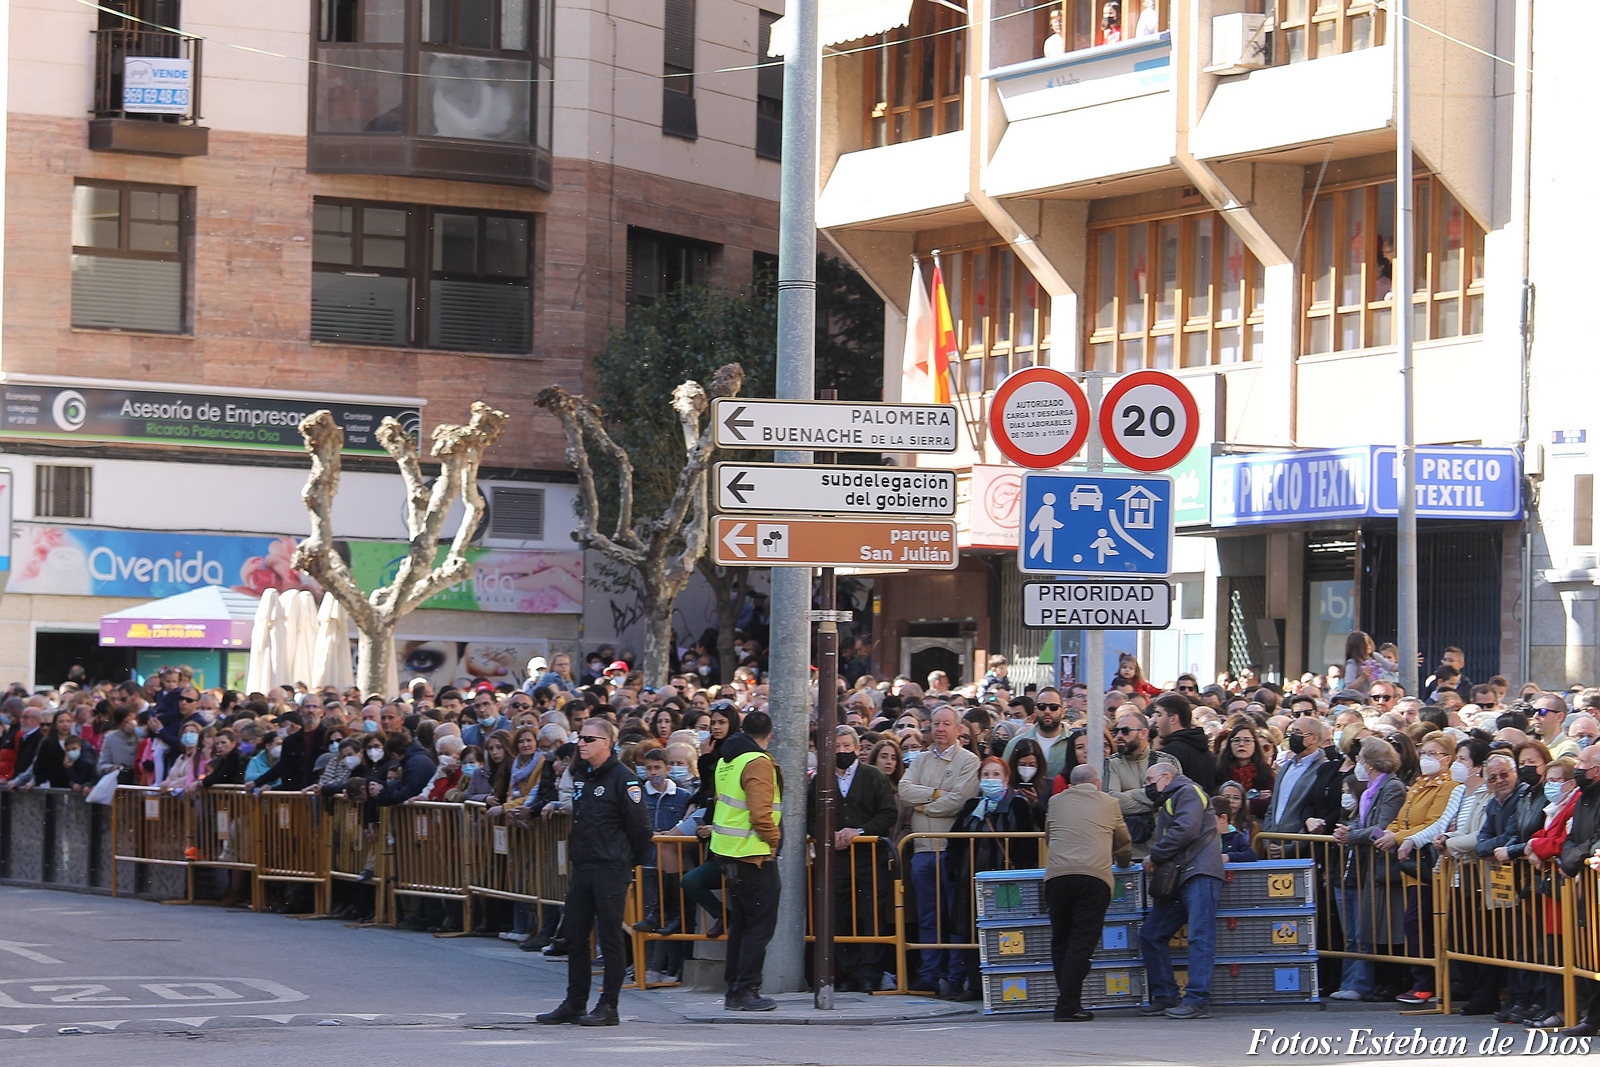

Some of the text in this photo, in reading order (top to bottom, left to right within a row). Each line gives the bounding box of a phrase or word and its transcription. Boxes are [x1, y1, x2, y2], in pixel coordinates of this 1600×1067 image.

[152, 68, 188, 79] VENDE
[124, 88, 189, 105] 969 69 48 48
[120, 398, 192, 420] Asesoría
[197, 402, 222, 422] de
[1016, 399, 1064, 409] AUTORIZADO
[851, 409, 951, 427] PALOMERA
[1006, 411, 1030, 420] CARGA
[1037, 409, 1074, 418] DESCARGA
[1027, 418, 1072, 428] LABORABLES
[1122, 404, 1176, 437] 20
[146, 422, 190, 437] Ricardo
[257, 428, 280, 442] Osa
[762, 427, 951, 446] BUENACHE DE LA SIERRA
[1422, 458, 1501, 482] PRECIO
[821, 473, 949, 492] subdelegación
[1240, 461, 1304, 513] PRECIO
[1308, 456, 1366, 509] TEXTIL
[845, 491, 948, 510] del gobierno
[1415, 484, 1486, 507] TEXTIL
[889, 528, 951, 545] parque
[859, 545, 951, 562] San Julián
[1038, 585, 1154, 601] PRIORIDAD
[1041, 608, 1153, 625] PEATONAL
